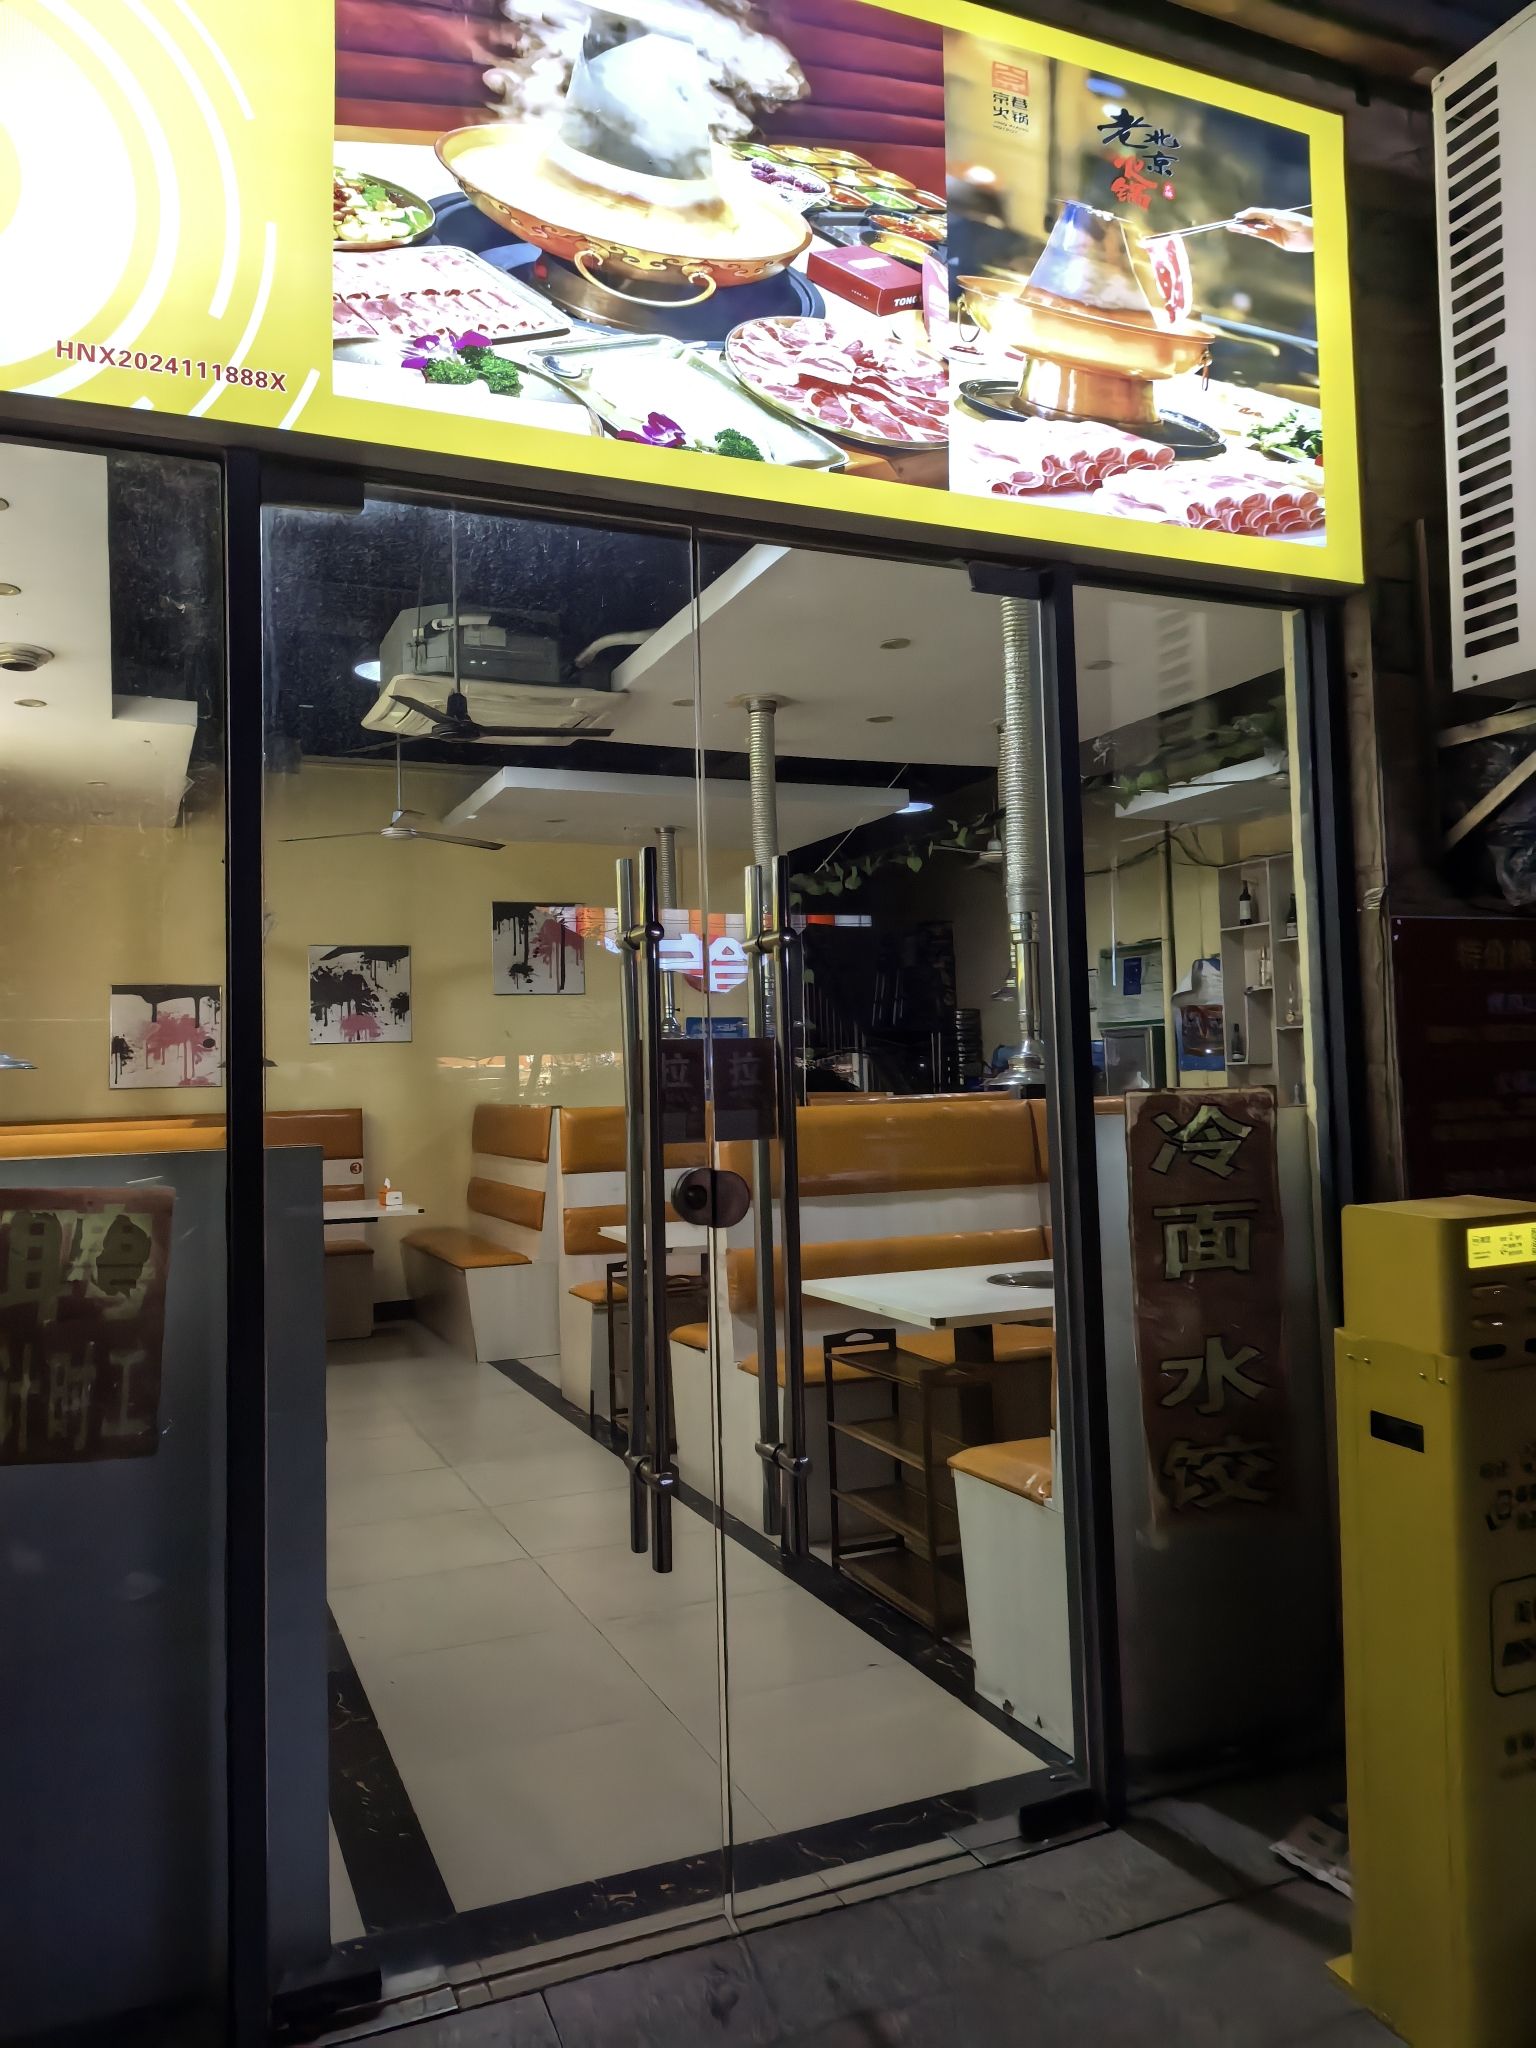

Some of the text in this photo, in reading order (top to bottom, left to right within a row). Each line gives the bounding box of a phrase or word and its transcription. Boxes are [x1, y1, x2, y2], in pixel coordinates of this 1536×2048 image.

[55, 339, 288, 393] HNX2024111888X
[661, 1052, 694, 1089] 拉
[728, 1051, 763, 1088] 拉
